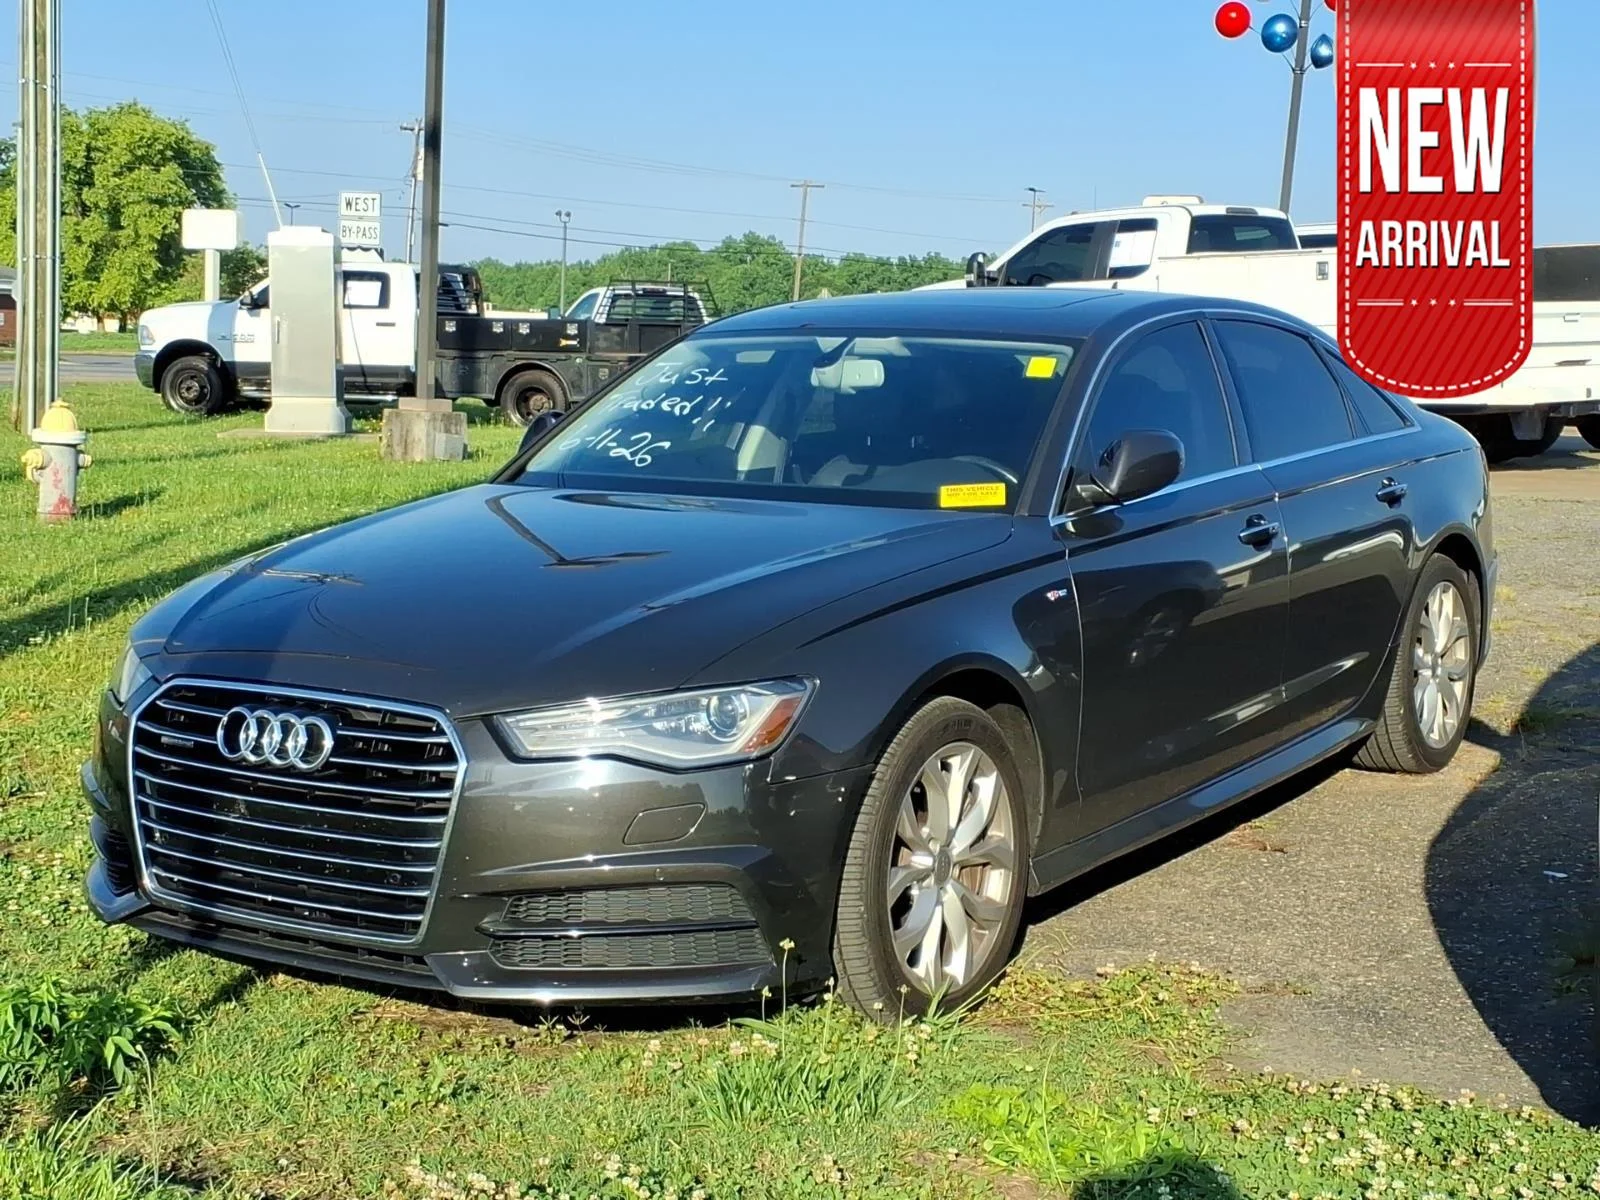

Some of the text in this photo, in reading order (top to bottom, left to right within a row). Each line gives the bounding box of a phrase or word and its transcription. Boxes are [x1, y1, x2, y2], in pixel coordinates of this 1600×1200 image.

[344, 196, 378, 212] WEST
[341, 224, 378, 240] BY-PASS
[635, 362, 729, 387] Just
[559, 424, 672, 468] 6-11-26
